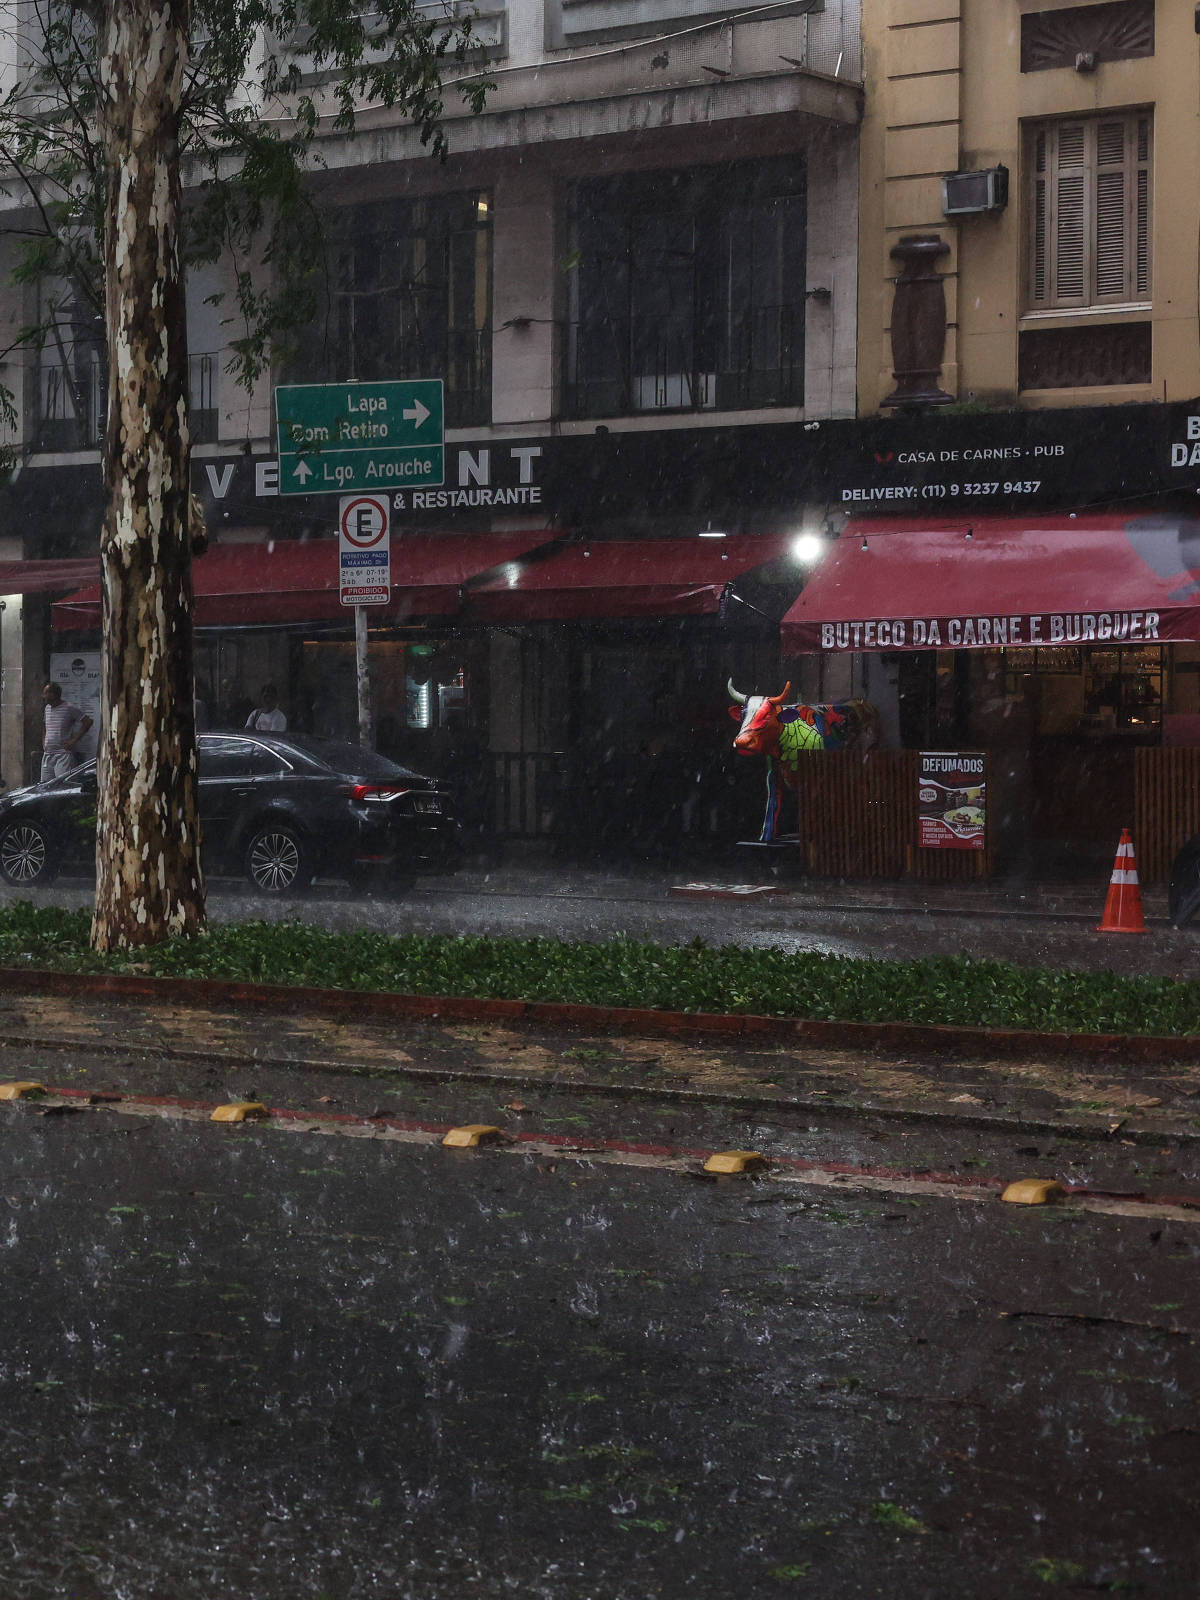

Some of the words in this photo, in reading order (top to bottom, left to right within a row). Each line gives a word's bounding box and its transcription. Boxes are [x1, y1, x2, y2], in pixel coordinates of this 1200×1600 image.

[348, 394, 388, 413] Lapa
[340, 421, 388, 440] Retiro
[898, 451, 936, 464] CASA
[940, 450, 959, 462] DE
[963, 447, 1022, 461] CARNES
[1034, 445, 1065, 457] PUB
[323, 463, 355, 487] Lgo.
[365, 457, 432, 478] Arouche
[393, 493, 406, 510] &
[412, 486, 542, 509] RESTAURANTE
[842, 485, 918, 501] DELIVERY:
[921, 484, 946, 499] (11)
[950, 483, 959, 496] 9
[963, 482, 1000, 496] 3237
[1003, 481, 1042, 494] 9437
[357, 509, 372, 536] E
[348, 586, 383, 595] PROIBIDO
[821, 620, 905, 648] BUTECO
[912, 618, 942, 646] DA
[948, 615, 1022, 646] CARNE
[1029, 615, 1043, 643] E
[1050, 611, 1160, 643] BURGUER
[922, 758, 984, 773] DEFUMADOS
